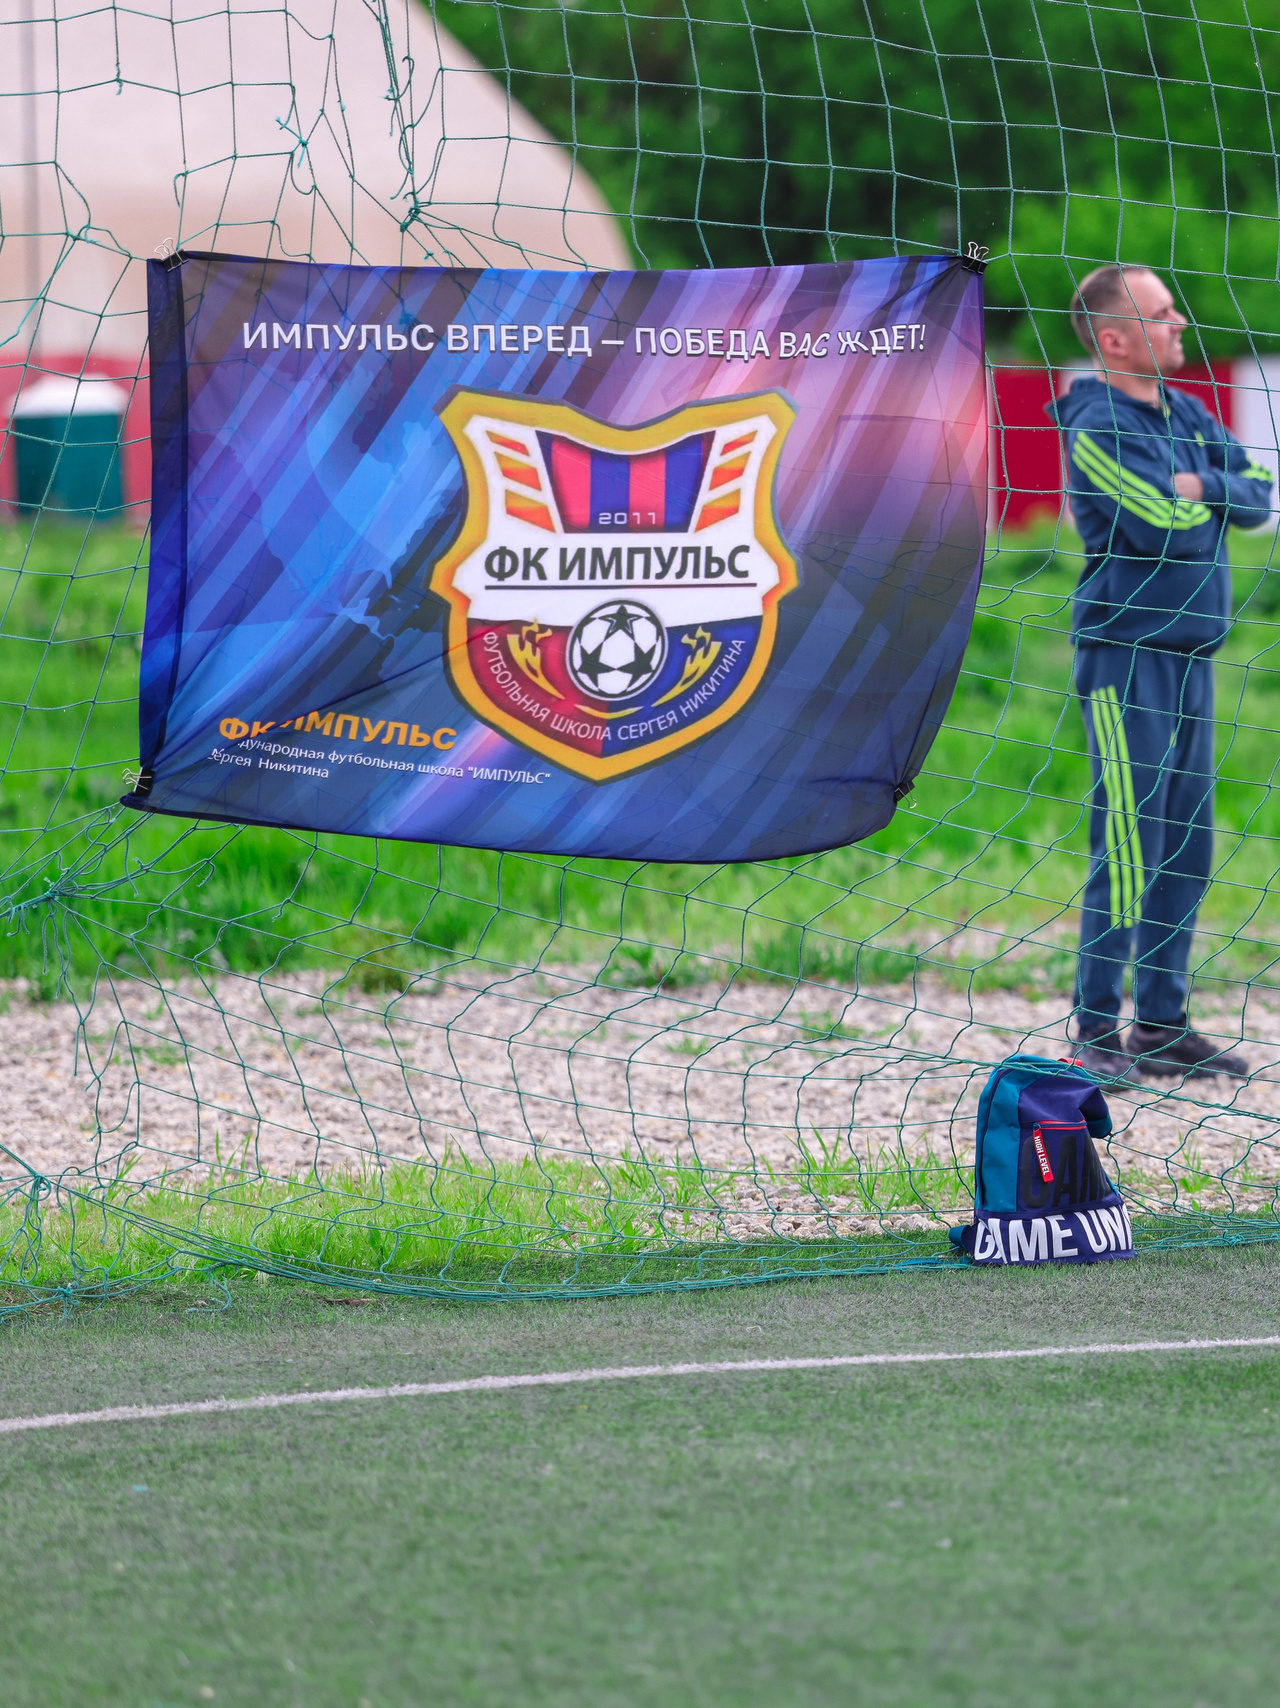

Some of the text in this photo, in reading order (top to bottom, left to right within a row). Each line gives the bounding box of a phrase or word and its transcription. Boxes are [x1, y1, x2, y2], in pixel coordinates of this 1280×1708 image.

[243, 322, 435, 351] ИМПУЛЬС
[447, 324, 592, 357] ВПЕРЕД
[635, 327, 771, 361] ПОБЕДА
[779, 330, 830, 358] ВАС
[598, 512, 656, 525] 2011
[484, 544, 750, 582] ФК ИМПУЛЬС
[482, 631, 746, 741] ФУТБОЛЬНАЯ ШКОЛА СЕРГЕЯ НИКИТИНА
[207, 751, 329, 779] ергея Никитина
[328, 750, 415, 772] футбольная
[417, 763, 464, 779] школа
[467, 765, 551, 785] "ИМПУЛЬС"
[1034, 1135, 1050, 1176] HIGH LEVEL
